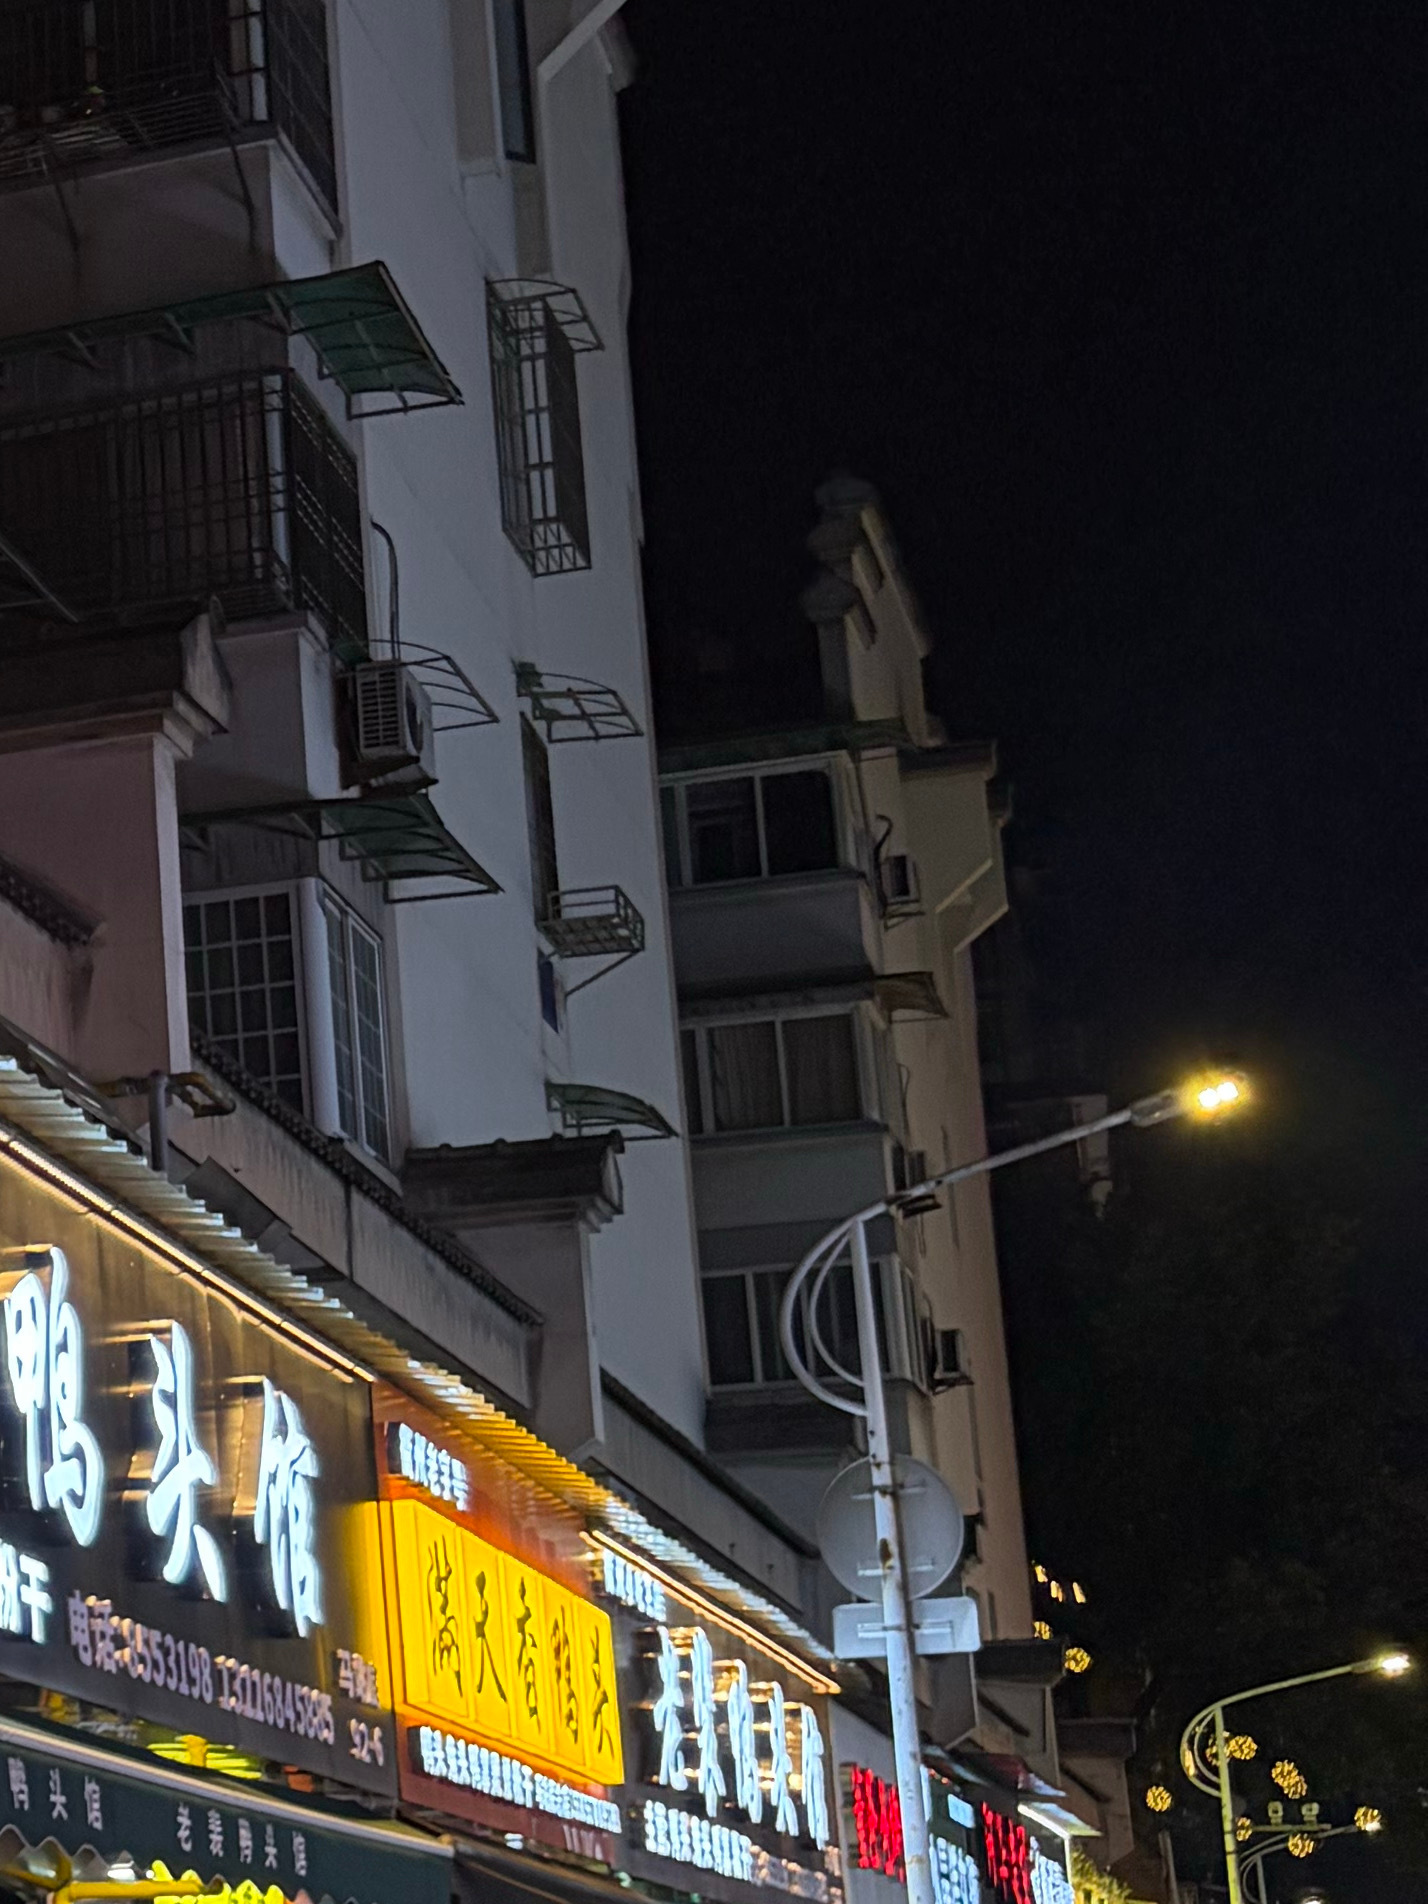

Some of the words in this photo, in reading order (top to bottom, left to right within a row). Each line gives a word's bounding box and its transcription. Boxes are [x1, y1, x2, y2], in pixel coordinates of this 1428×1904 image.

[427, 1535, 615, 1756] 满天香鸭头
